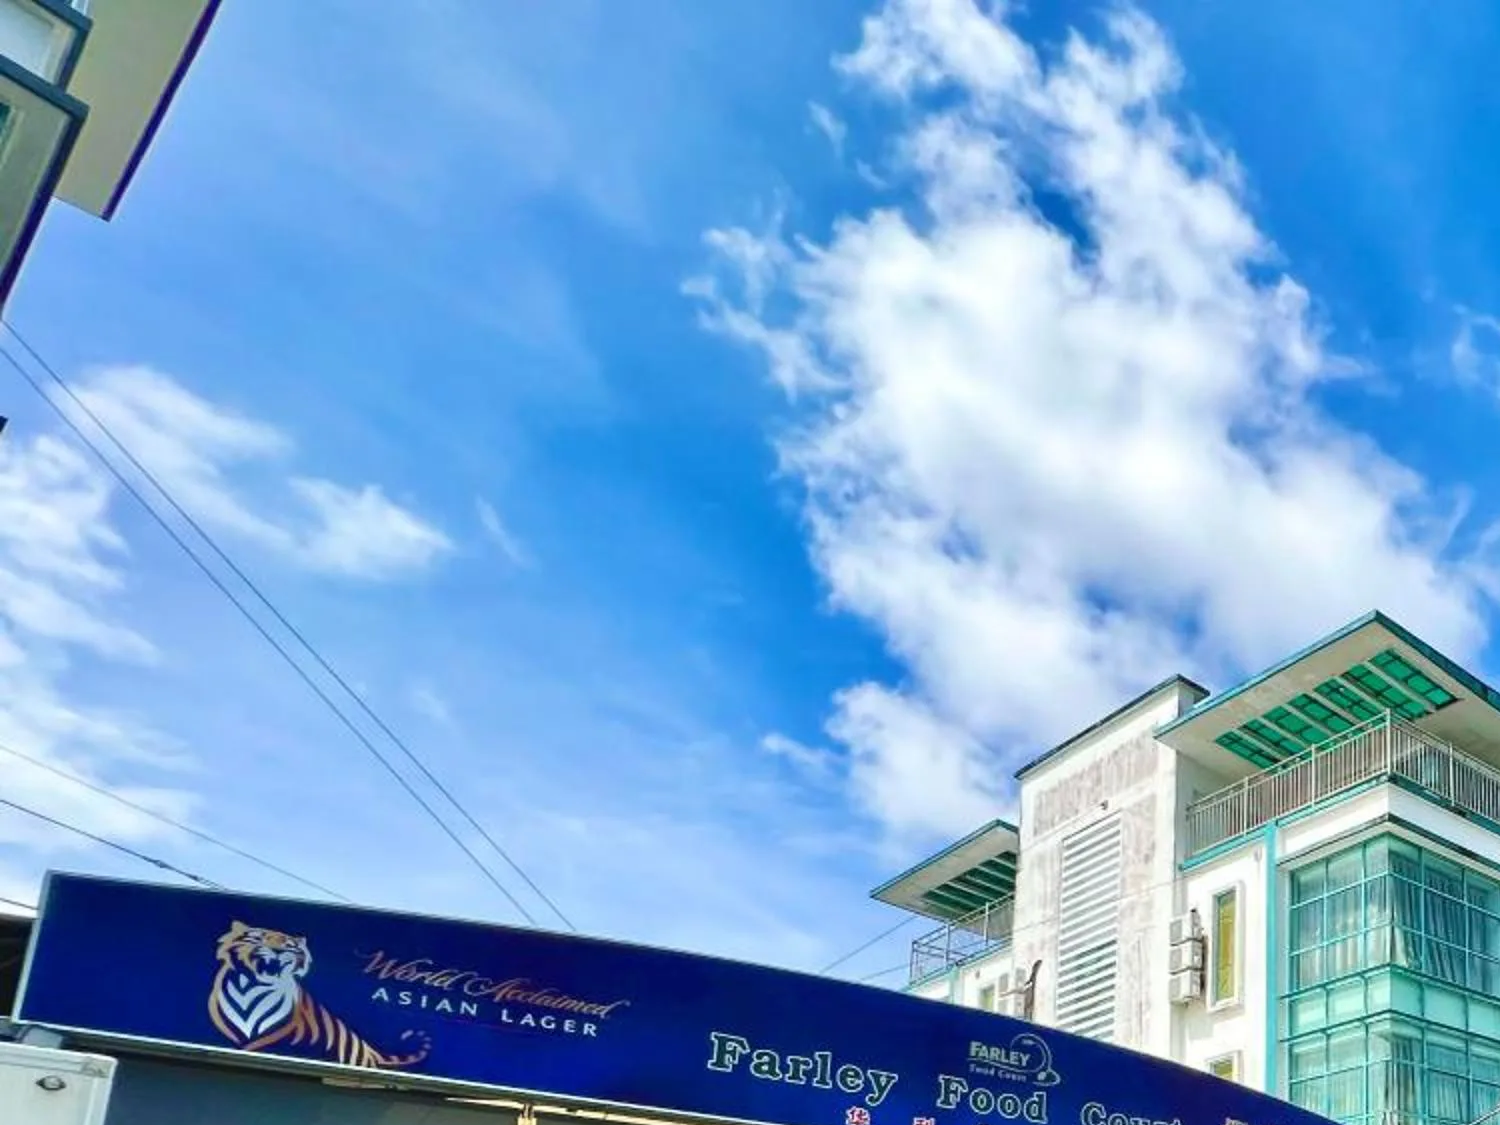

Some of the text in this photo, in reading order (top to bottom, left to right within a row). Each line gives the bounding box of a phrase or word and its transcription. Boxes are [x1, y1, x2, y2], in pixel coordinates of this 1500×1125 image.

[356, 949, 630, 1020] World Acclaimed
[371, 987, 598, 1037] ASIAN LAGER
[707, 1031, 899, 1106] Farley
[936, 1074, 1049, 1125] Food
[969, 1040, 1031, 1068] FARLEY
